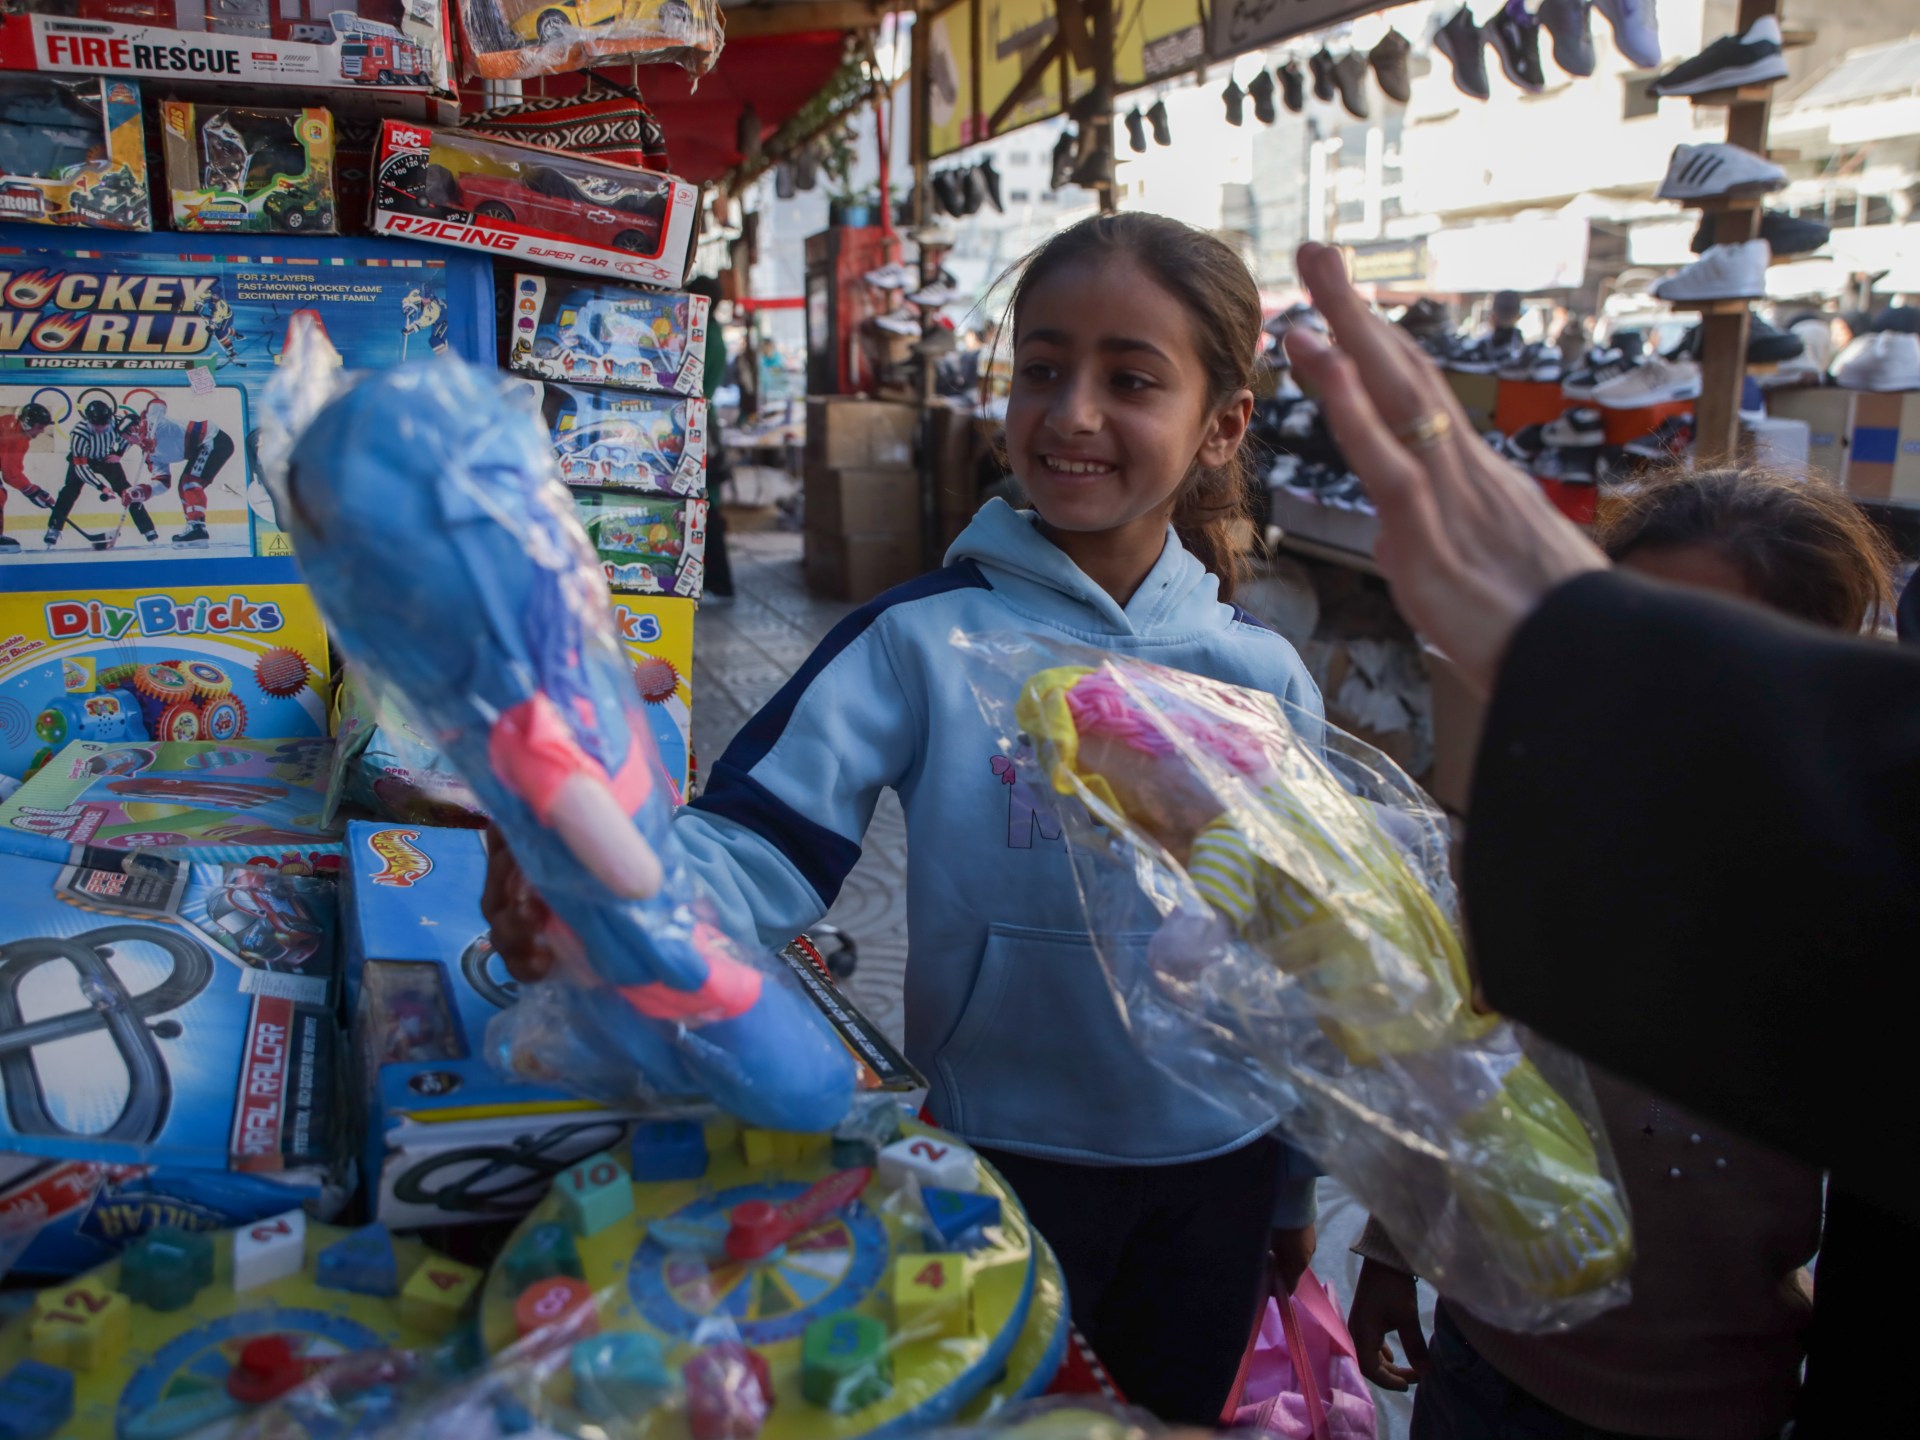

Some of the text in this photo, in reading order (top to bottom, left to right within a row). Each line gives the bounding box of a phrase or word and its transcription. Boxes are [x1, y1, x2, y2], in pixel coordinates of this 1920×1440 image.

[46, 35, 241, 75] FIRE RESCUE
[394, 168, 407, 176] 100
[405, 160, 419, 169] 120
[384, 196, 395, 205] 60
[446, 213, 460, 222] 220
[385, 214, 609, 268] RACING SUPER CAR
[236, 273, 315, 283] FOR 2 PLAYERS
[237, 282, 383, 293] FAST-MOVING HOCKEY GAME
[238, 292, 296, 301] EXCITMENT
[321, 293, 341, 302] THE
[342, 294, 377, 302] FAMILY
[30, 358, 187, 370] HOCKEY GAME
[48, 597, 281, 638] Diy Bricks
[384, 767, 410, 777] OPEN
[908, 1140, 949, 1163] 2
[569, 1161, 619, 1191] 10
[252, 1219, 292, 1242] 2
[427, 1268, 466, 1293] 4
[913, 1260, 947, 1290] 4
[44, 1287, 113, 1328] 12
[533, 1285, 573, 1319] 8
[826, 1319, 860, 1355] 5
